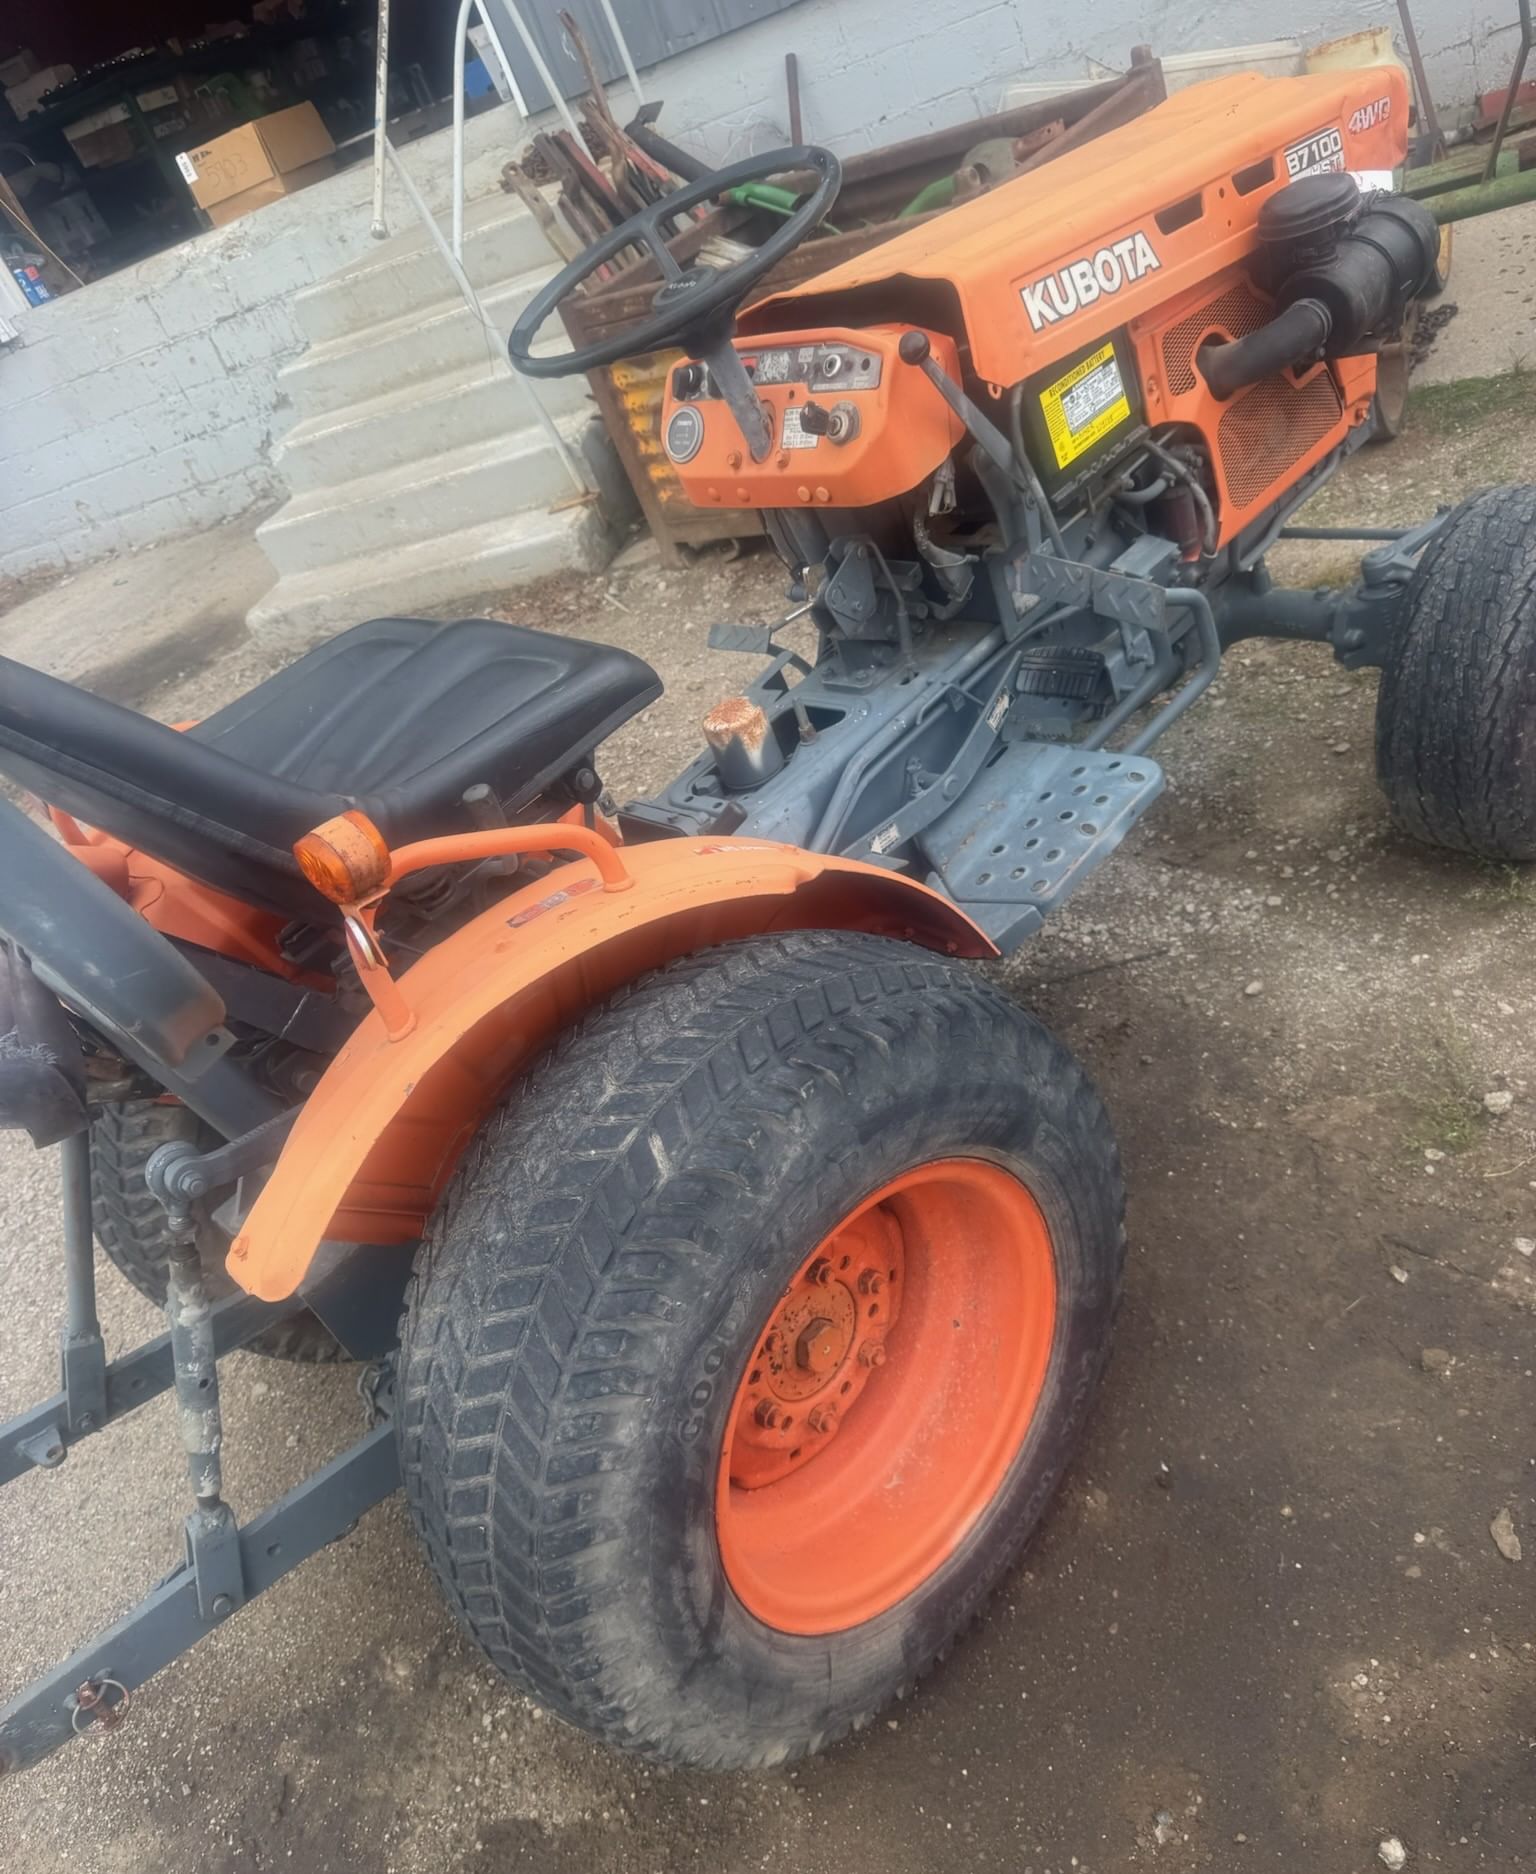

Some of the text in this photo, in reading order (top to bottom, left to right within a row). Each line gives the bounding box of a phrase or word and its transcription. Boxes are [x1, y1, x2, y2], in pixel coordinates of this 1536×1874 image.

[1348, 97, 1391, 134] 4WD
[1285, 130, 1342, 177] B7100
[1019, 230, 1162, 333] KUBOTA
